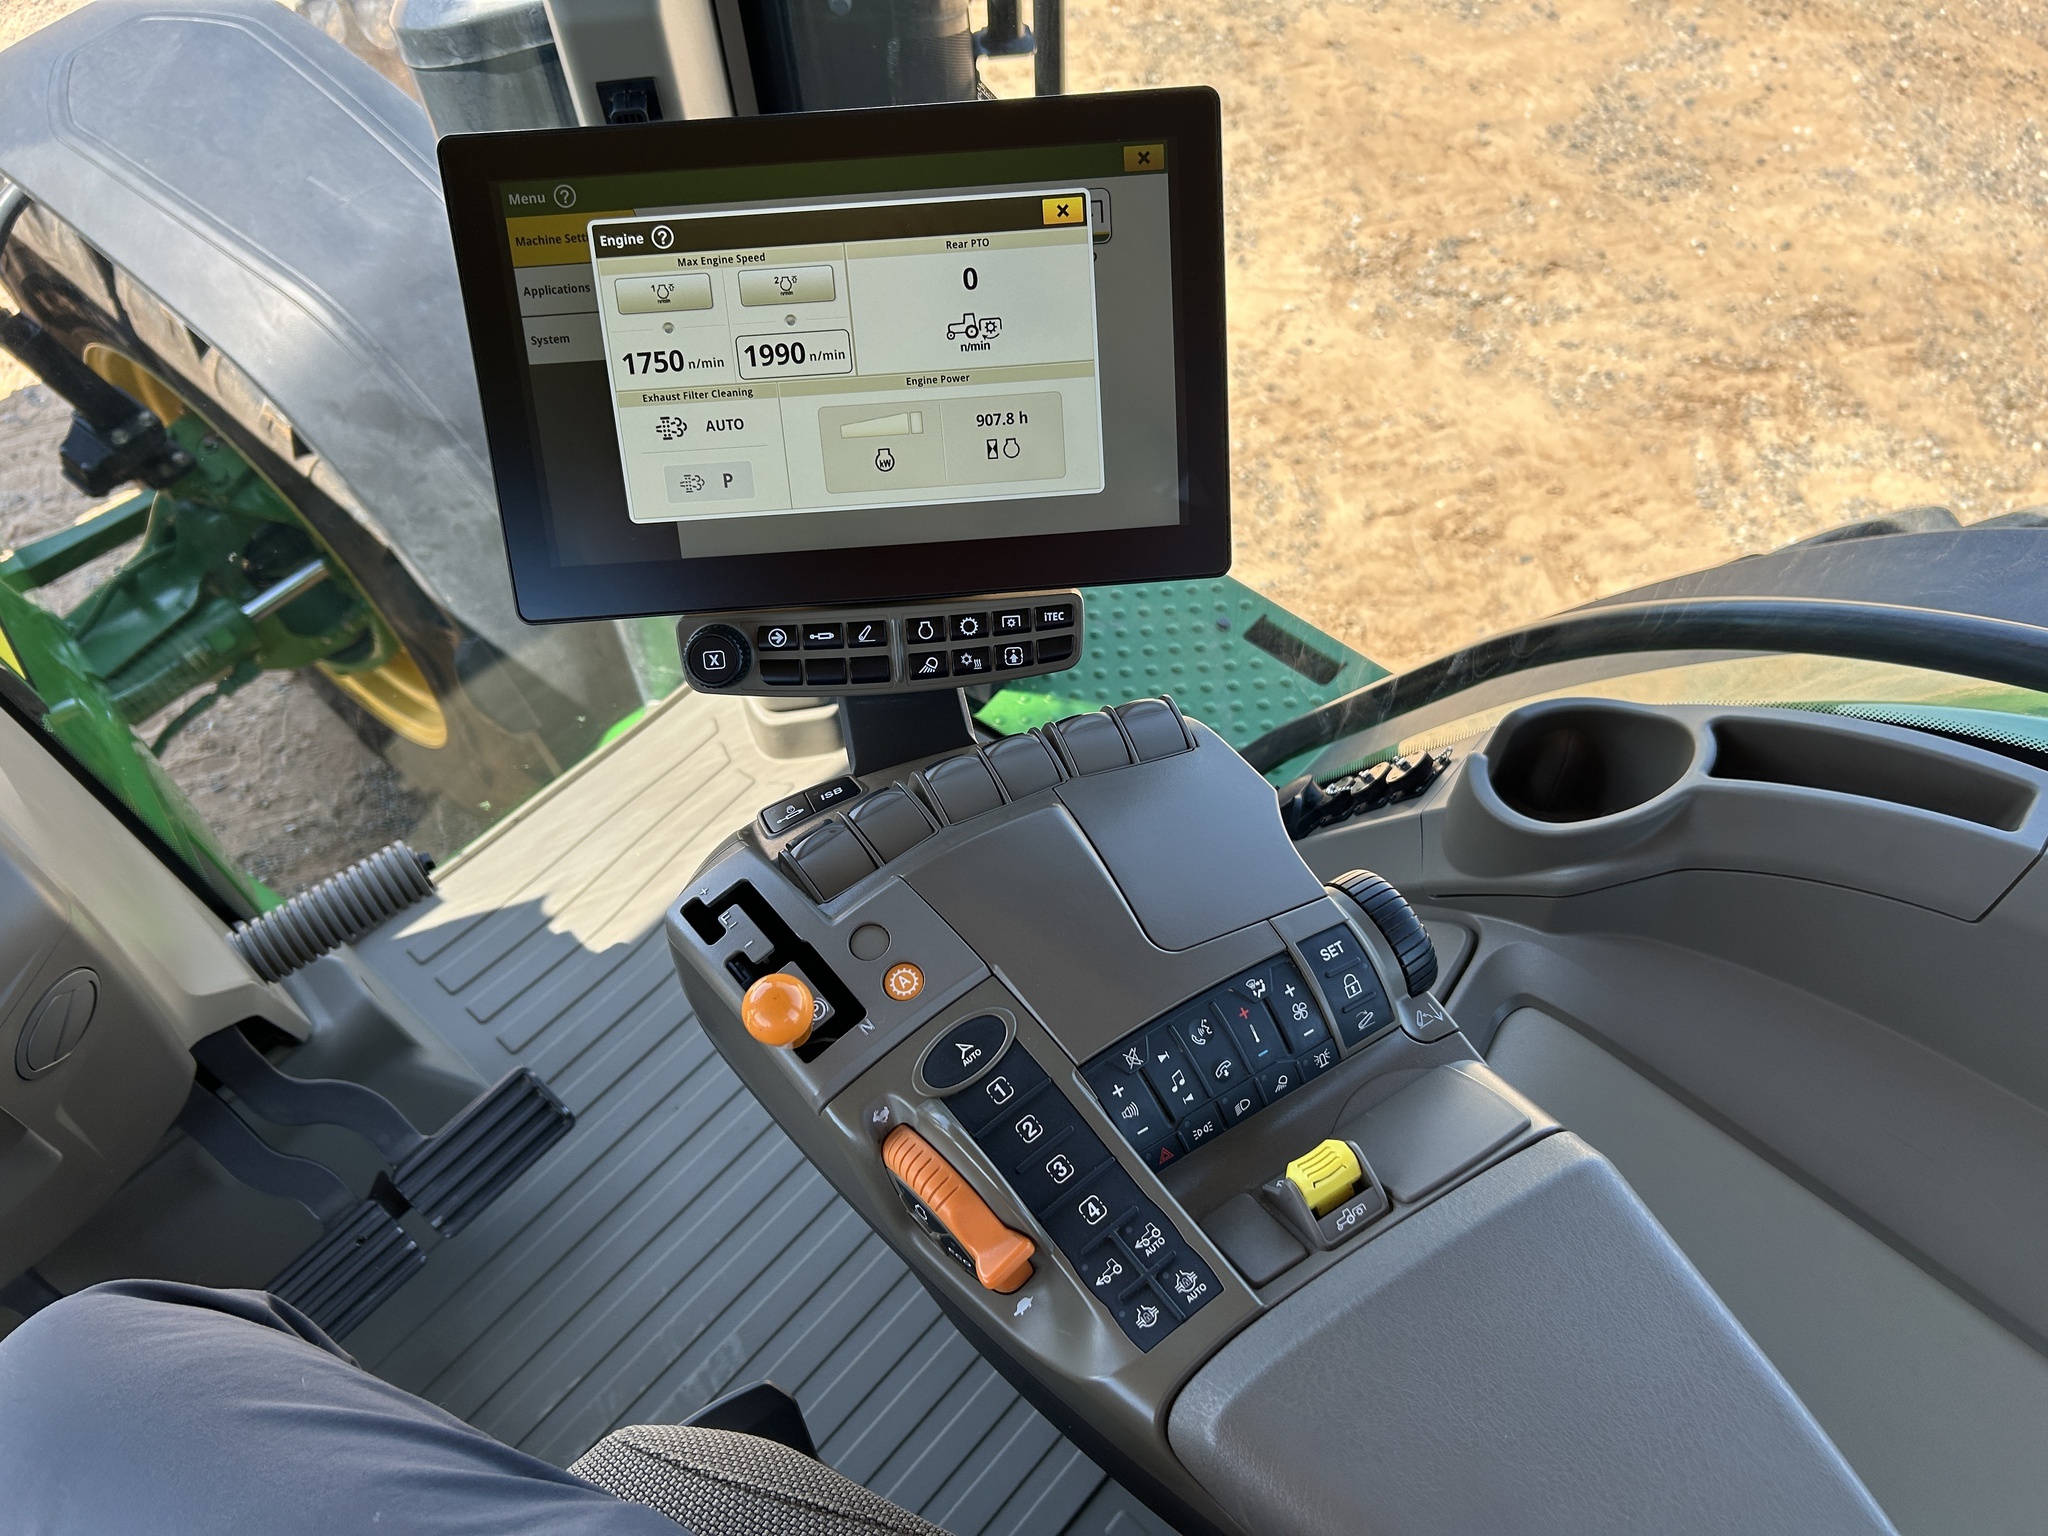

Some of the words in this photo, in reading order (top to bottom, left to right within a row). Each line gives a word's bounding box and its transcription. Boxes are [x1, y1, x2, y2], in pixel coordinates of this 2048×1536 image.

[508, 193, 546, 206] Menu
[515, 233, 562, 247] Machine
[564, 231, 589, 244] Setti
[599, 232, 645, 249] Engine
[945, 239, 968, 250] Rear
[970, 237, 990, 248] PTO
[677, 257, 698, 267] Max
[700, 254, 734, 267] Engine
[736, 252, 766, 265] Speed
[773, 276, 780, 285] 2
[962, 267, 979, 290] 0
[523, 283, 591, 299] Applications
[530, 334, 571, 348] System
[960, 340, 991, 352] n/min
[622, 349, 685, 375] 1750
[688, 357, 725, 370] n/min
[744, 341, 806, 368] 1990
[809, 349, 846, 362] n/min
[906, 375, 938, 388] Engine
[940, 373, 971, 384] Power
[642, 391, 681, 403] Exhaust
[683, 389, 709, 401] Filter
[711, 387, 754, 399] Cleaning
[705, 418, 745, 432] AUTO
[976, 411, 1015, 428] 907.8
[1019, 410, 1029, 424] h
[879, 459, 892, 470] kW
[722, 473, 734, 489] P
[1043, 611, 1066, 622] iTEC
[820, 786, 844, 801] ISB
[1319, 940, 1344, 962] SET
[897, 974, 912, 990] A
[962, 1048, 982, 1068] AUTO
[994, 1083, 1007, 1097] 1
[1022, 1121, 1038, 1138] 2
[1053, 1161, 1068, 1177] 3
[1087, 1201, 1101, 1218] 4
[1144, 1236, 1166, 1258] AUTO
[1186, 1282, 1207, 1304] AUTO
